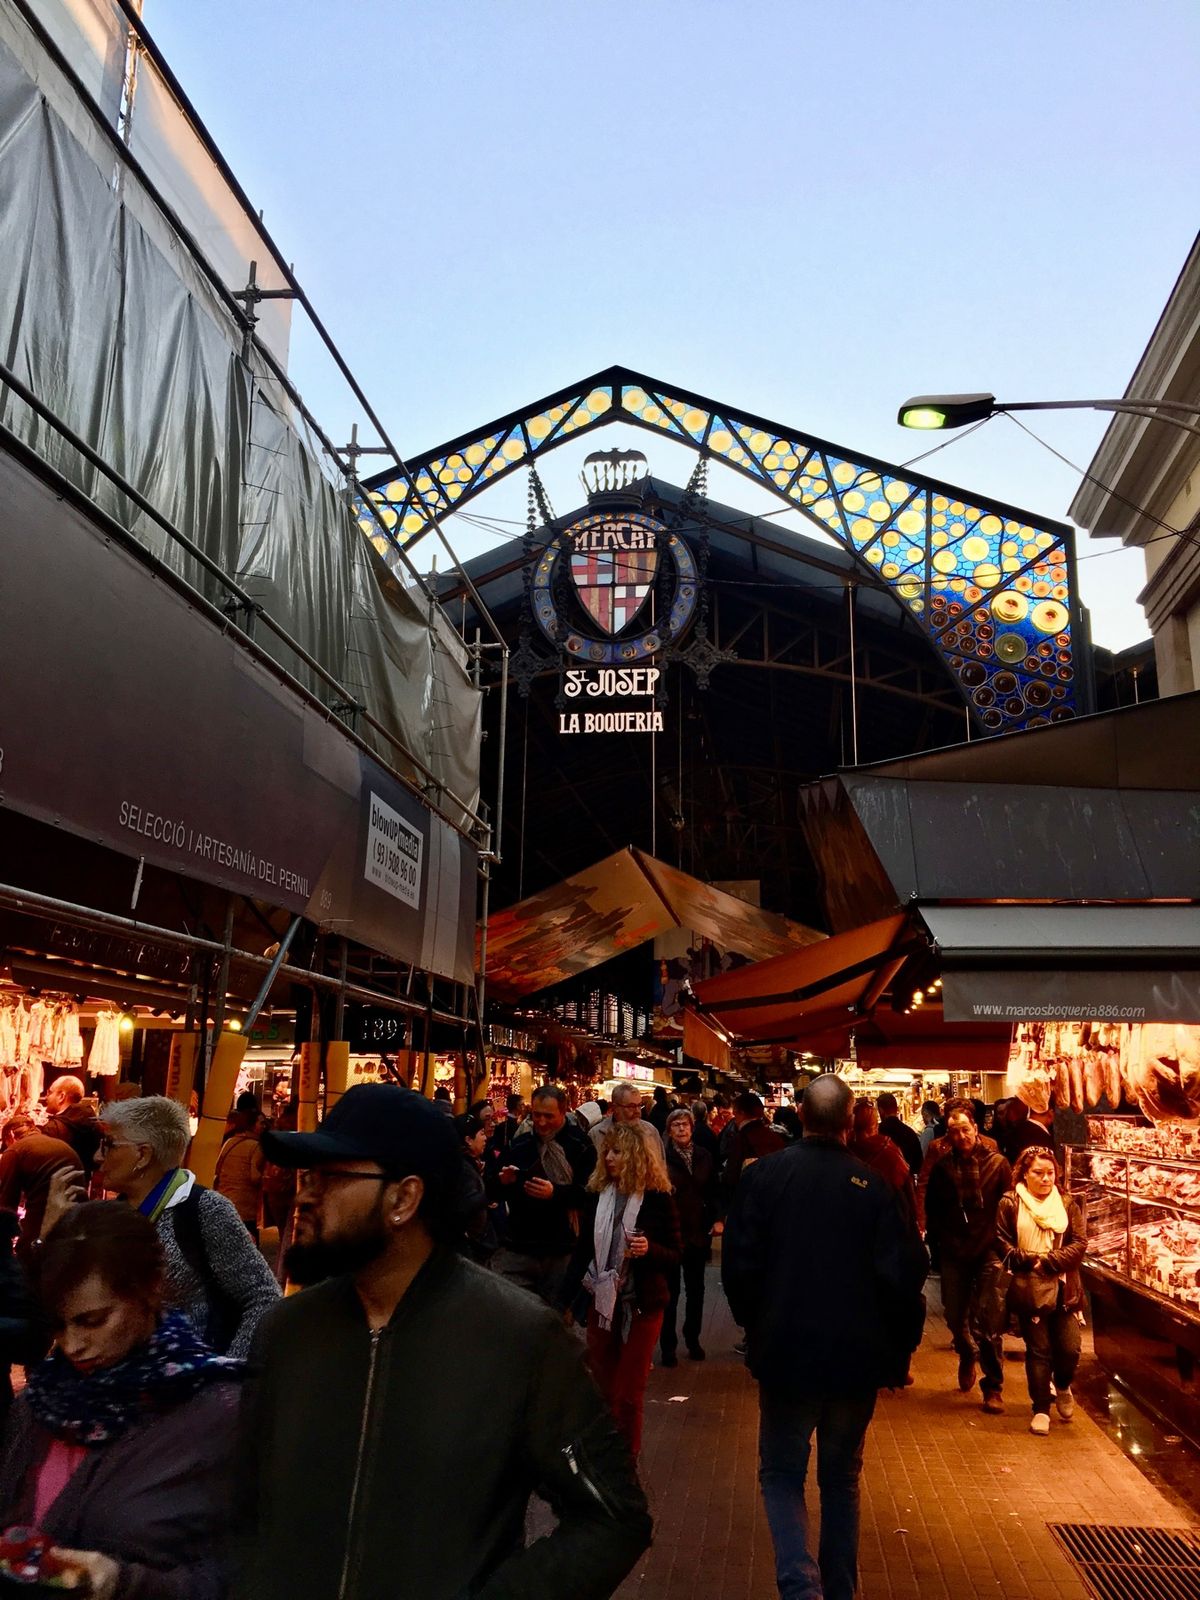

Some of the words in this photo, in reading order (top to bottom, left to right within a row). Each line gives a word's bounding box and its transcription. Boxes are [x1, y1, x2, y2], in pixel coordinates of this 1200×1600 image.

[586, 668, 660, 696] JOSEP
[560, 714, 580, 733] LA
[584, 712, 664, 732] BOQUERIA
[119, 801, 186, 848] SELECCIÓ
[195, 832, 257, 877] ARTESANÍA
[258, 859, 277, 885] DEL
[279, 868, 311, 899] PERNIL
[973, 1003, 1145, 1019] www.marcosboqueria886.com
